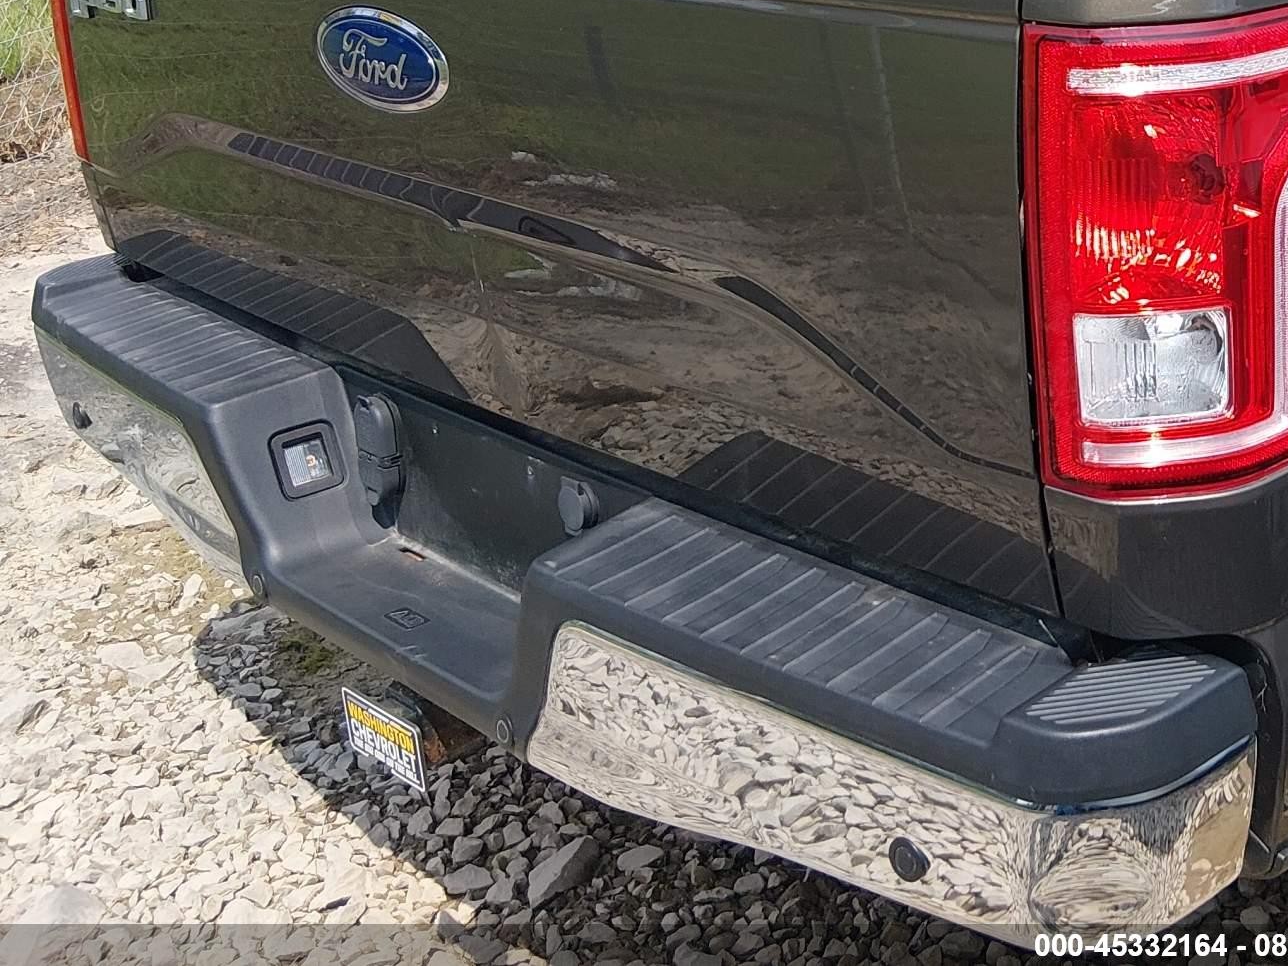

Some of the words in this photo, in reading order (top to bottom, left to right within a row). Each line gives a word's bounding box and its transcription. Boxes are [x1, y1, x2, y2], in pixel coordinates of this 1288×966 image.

[340, 28, 408, 90] Ford
[347, 699, 415, 755] WASHINGTON
[350, 718, 417, 773] CHEVROLET
